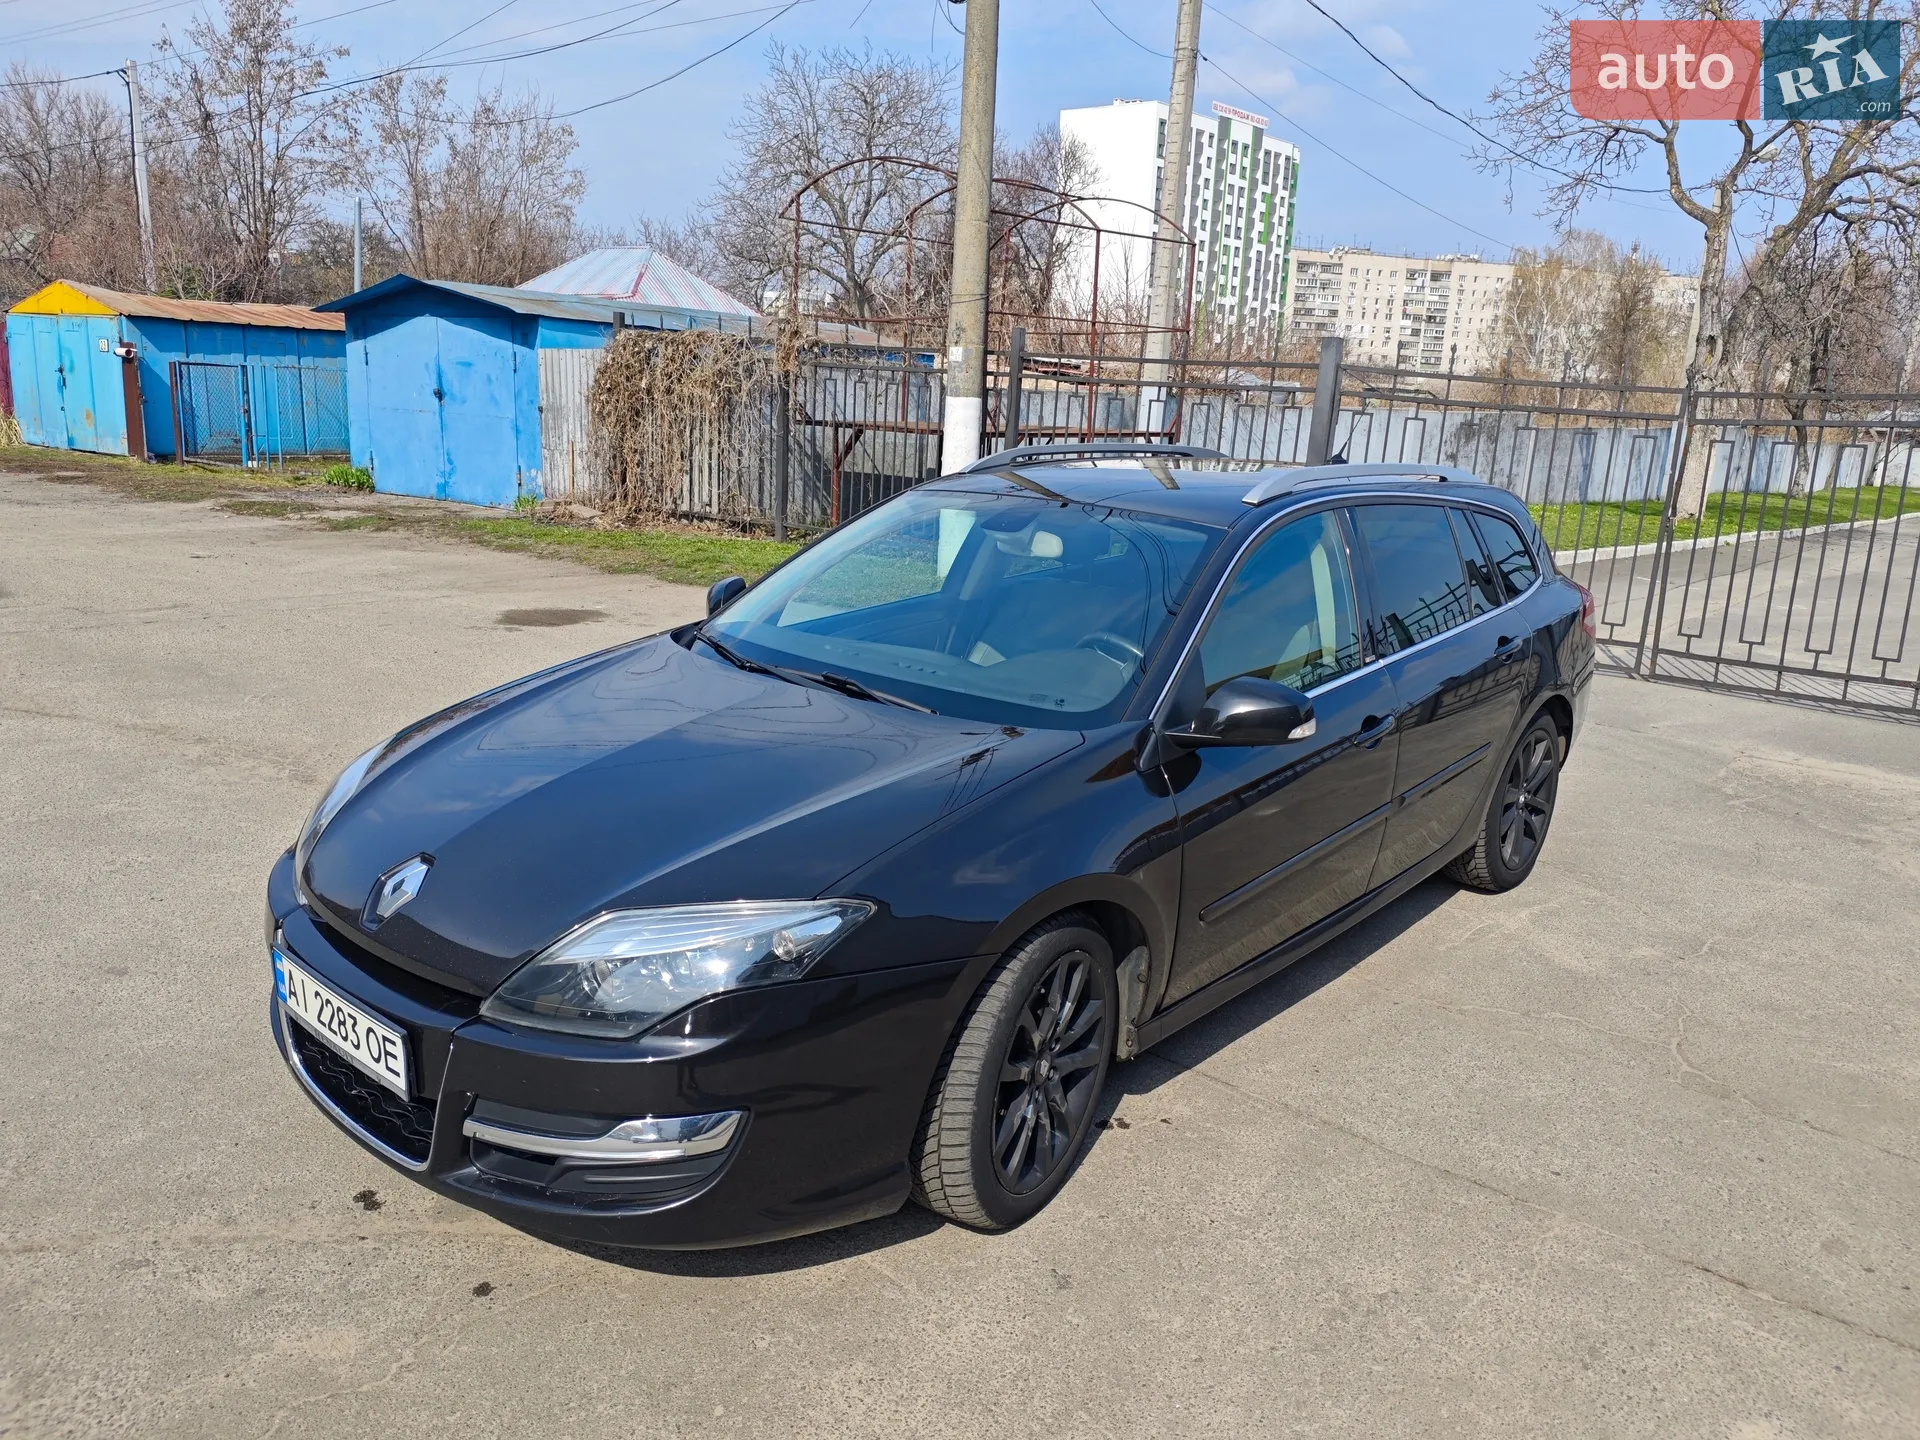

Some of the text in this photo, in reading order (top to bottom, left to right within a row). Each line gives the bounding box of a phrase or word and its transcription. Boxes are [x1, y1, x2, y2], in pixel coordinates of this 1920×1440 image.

[288, 968, 401, 1079] AI 2283 OE
